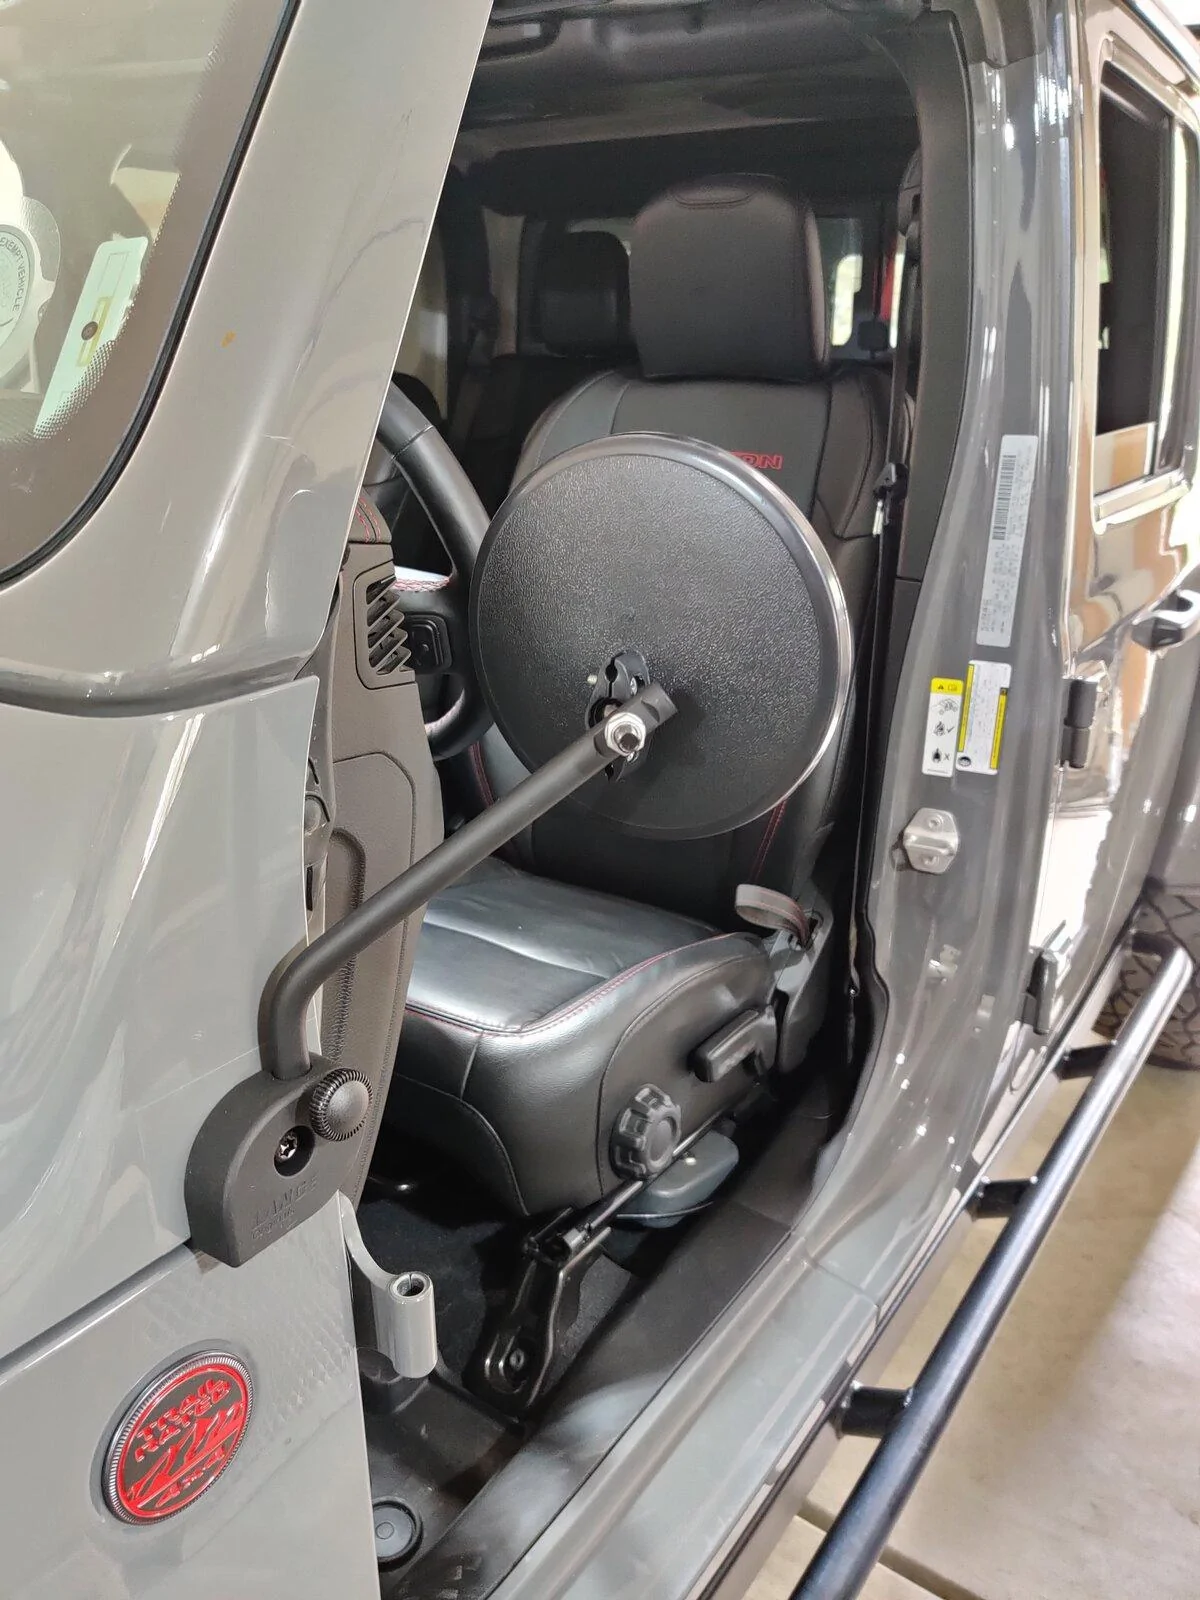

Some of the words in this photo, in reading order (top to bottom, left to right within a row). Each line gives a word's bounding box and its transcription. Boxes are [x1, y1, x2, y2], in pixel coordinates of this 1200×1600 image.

[13, 262, 26, 312] VEHICLE
[134, 1381, 231, 1462] RATED
[136, 1379, 224, 1440] TRAIL
